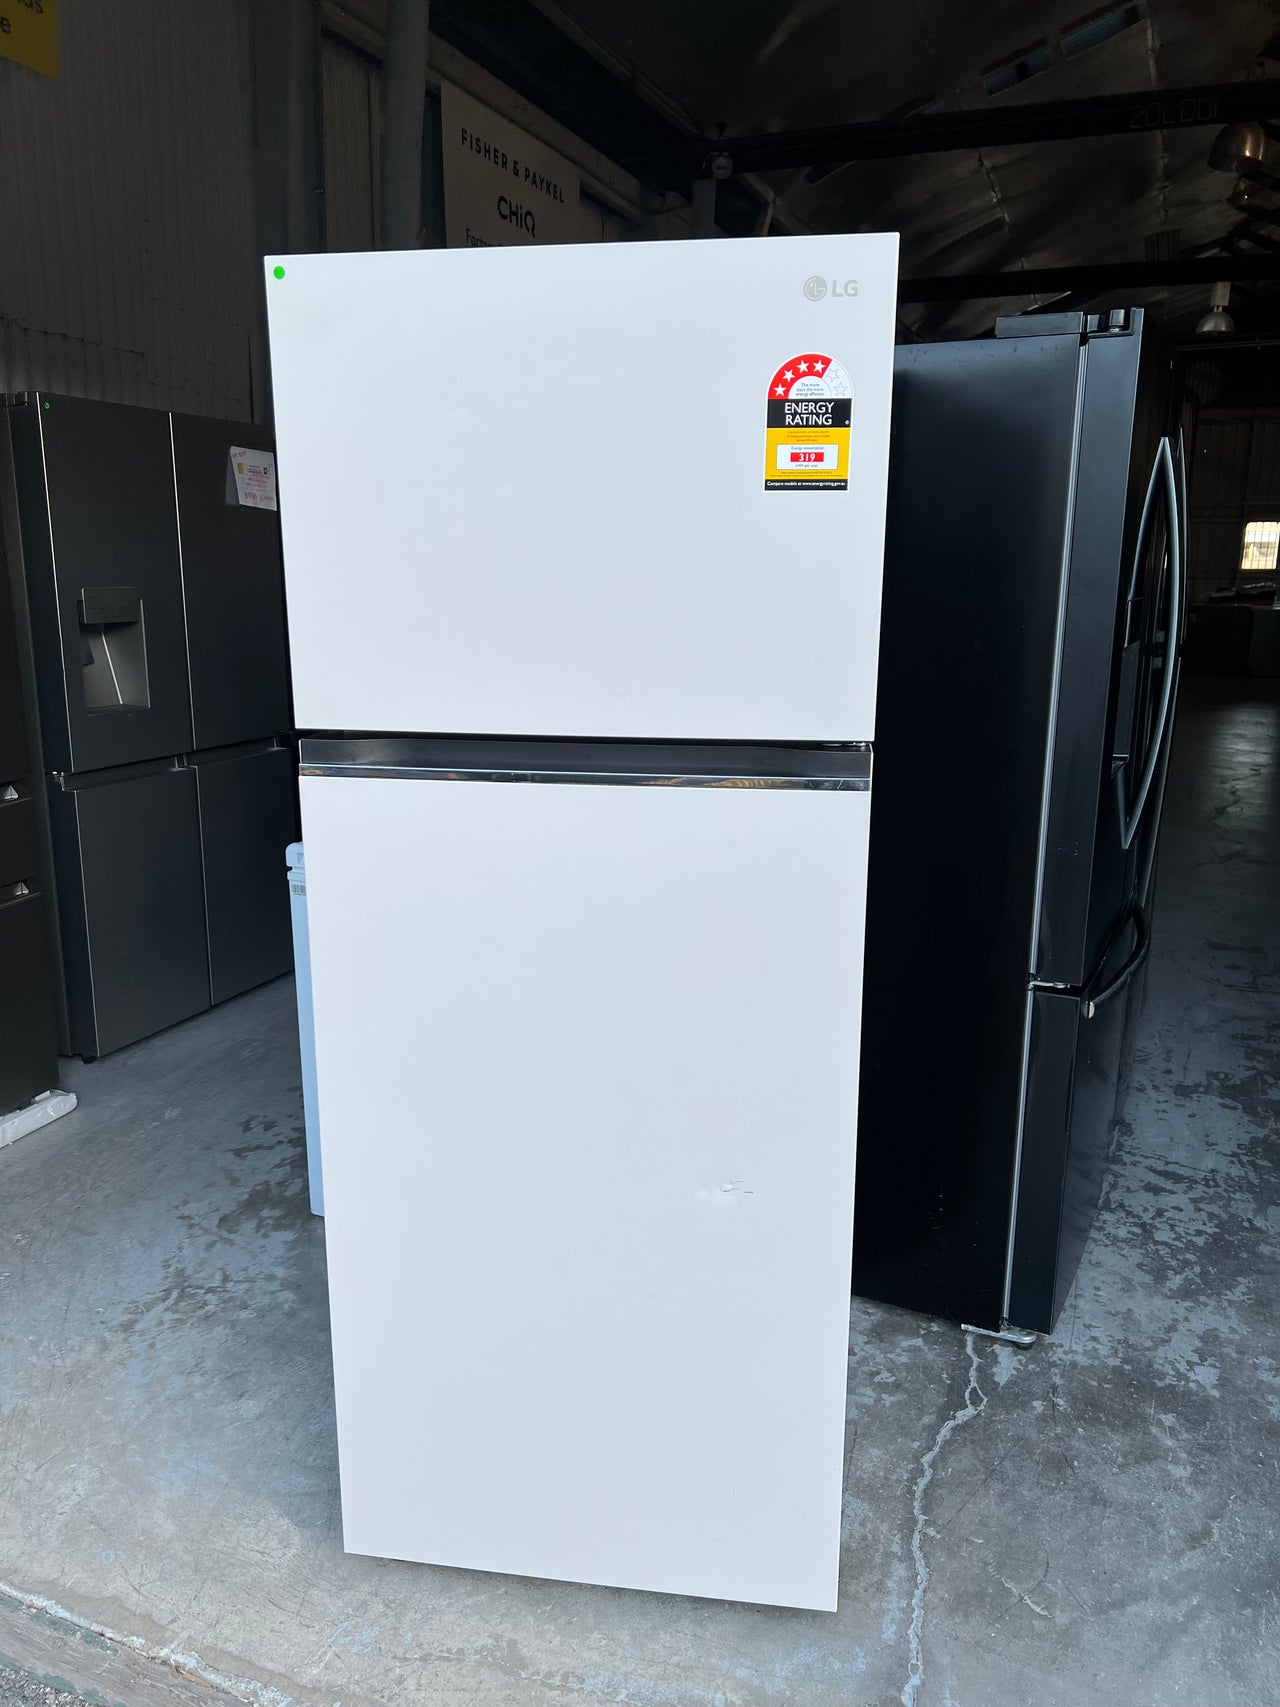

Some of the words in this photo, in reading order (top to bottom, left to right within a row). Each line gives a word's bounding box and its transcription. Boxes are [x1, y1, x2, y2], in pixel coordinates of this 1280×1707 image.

[461, 127, 508, 170] FISHER
[512, 159, 520, 178] &
[524, 166, 565, 204] PAYKEL
[832, 279, 859, 298] LG
[785, 402, 834, 413] ENERGY
[785, 414, 833, 426] RATING
[799, 453, 815, 462] 319
